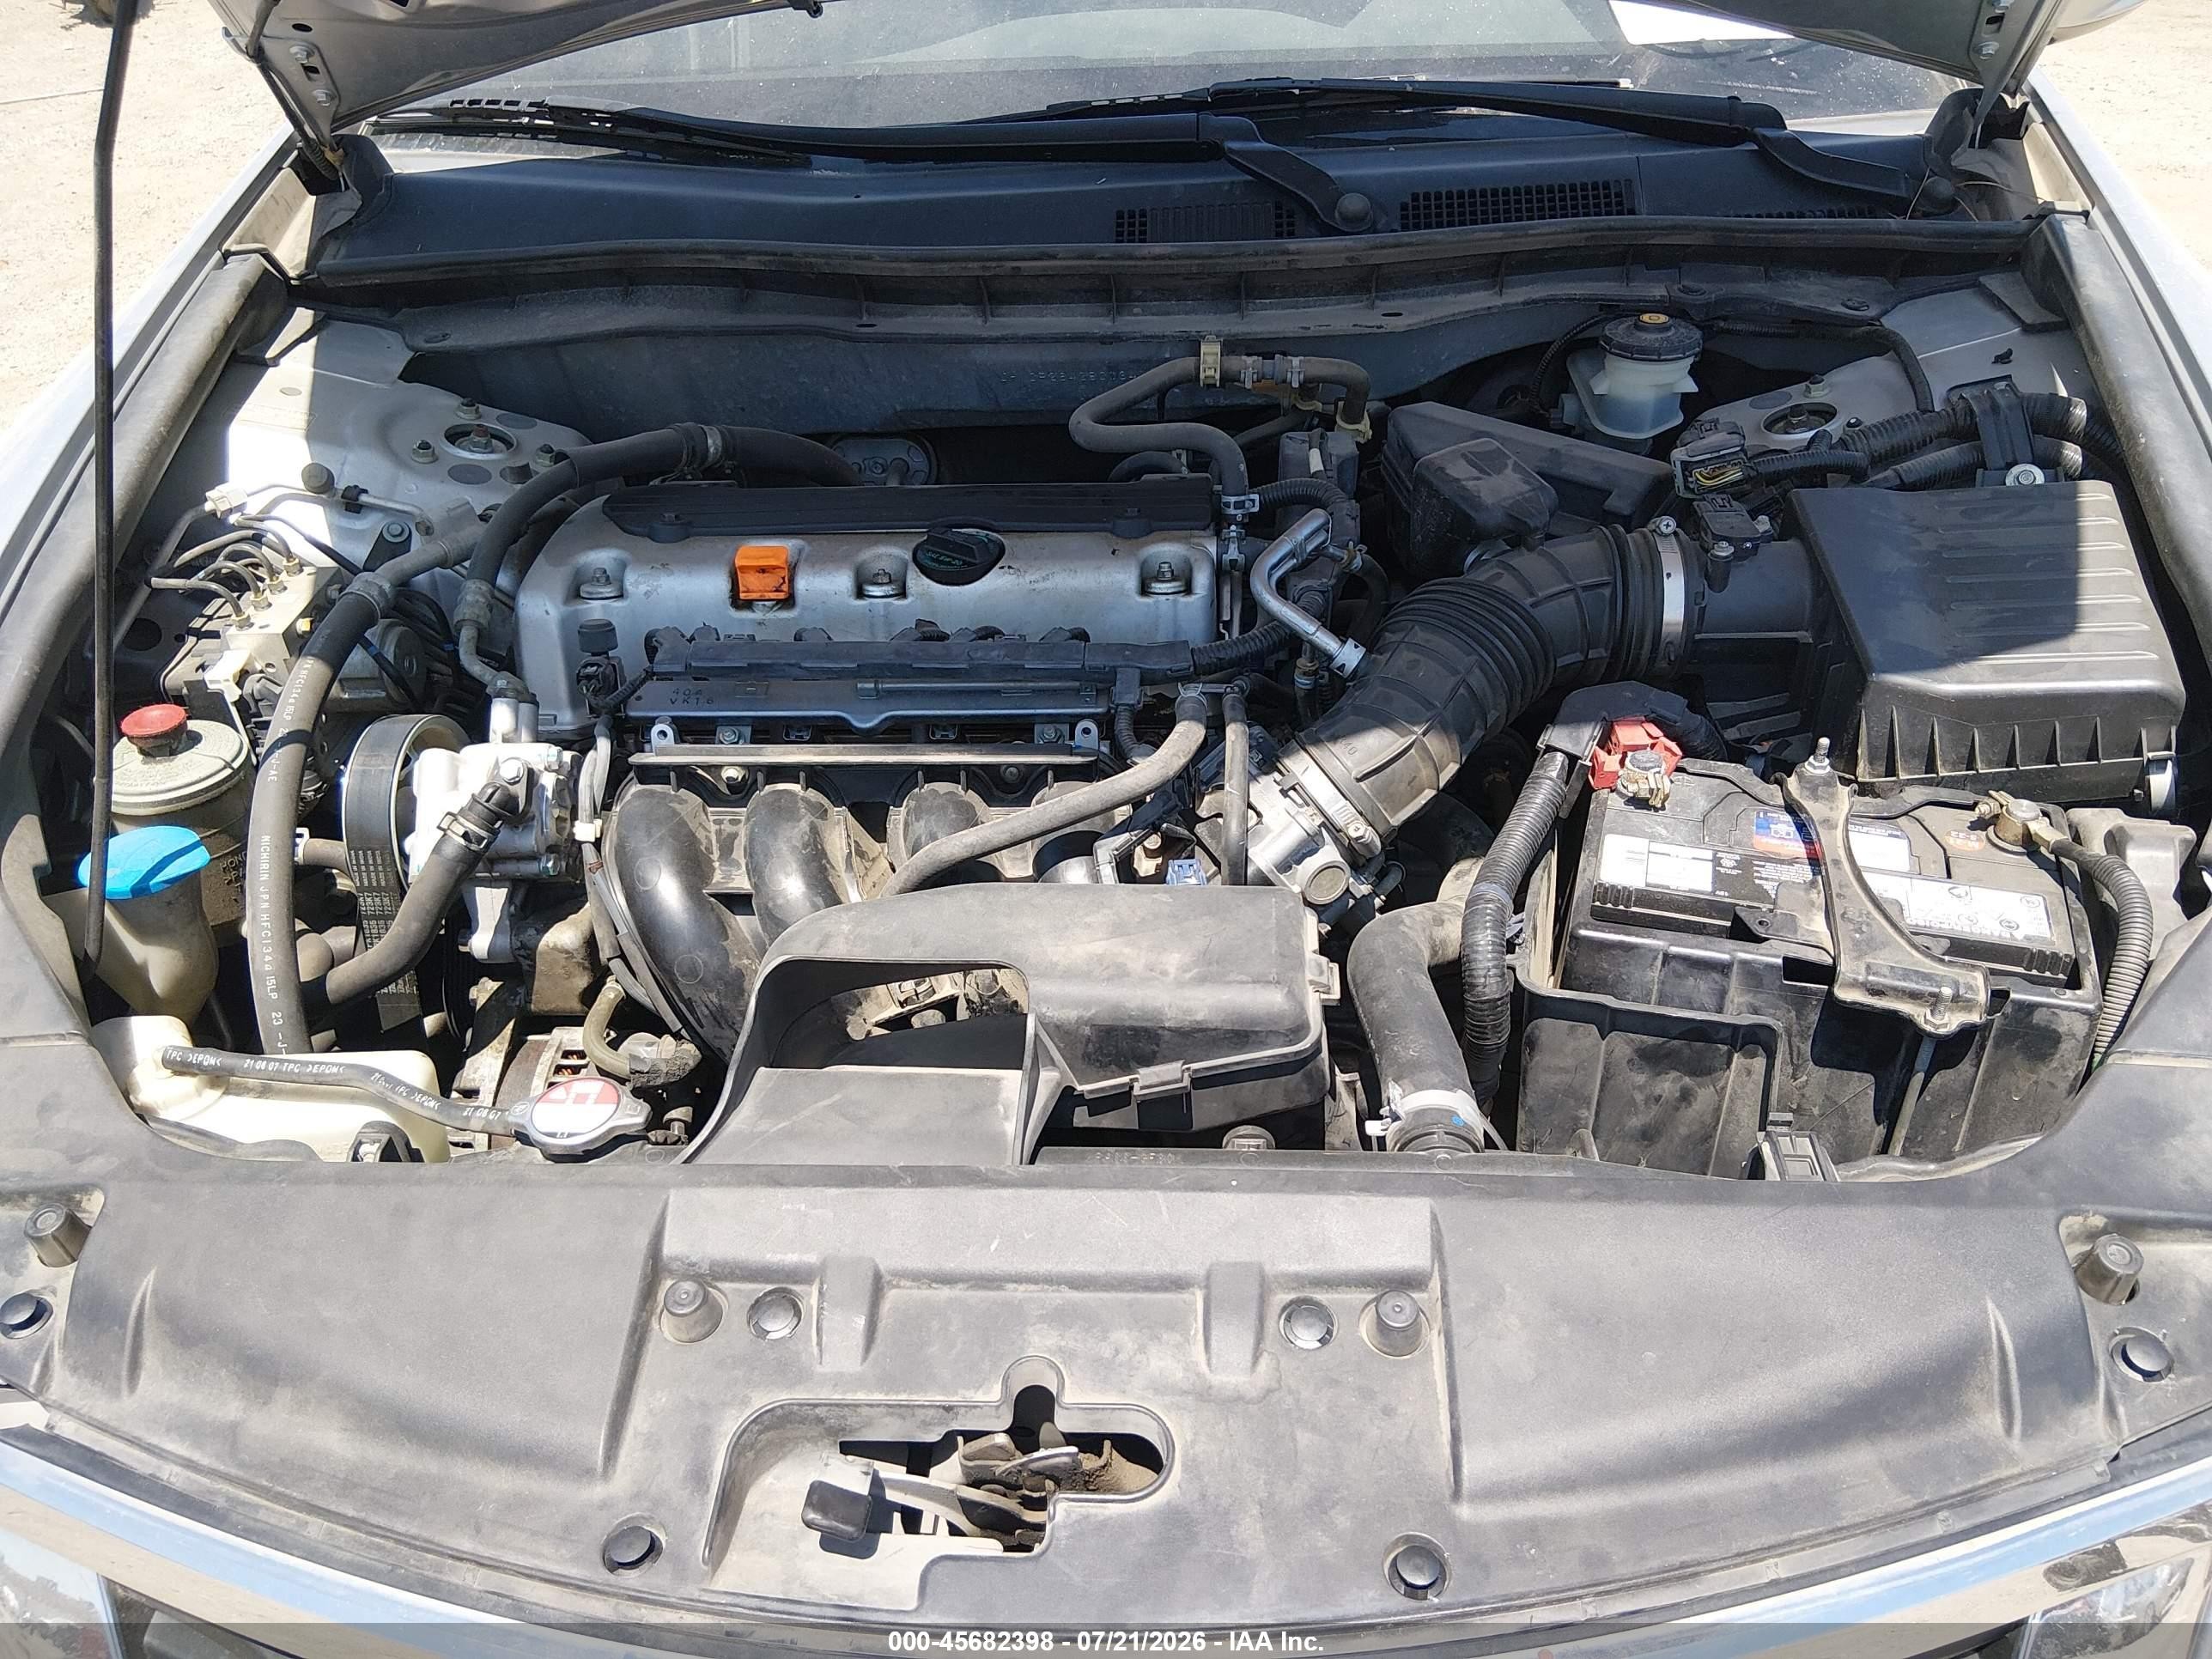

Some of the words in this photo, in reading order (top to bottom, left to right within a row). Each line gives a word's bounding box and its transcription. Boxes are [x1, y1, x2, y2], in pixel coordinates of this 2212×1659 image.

[258, 835, 271, 881] NICHIRIN
[258, 885, 271, 909] JPN
[363, 891, 375, 915] 723K7
[372, 891, 384, 915] 723K7
[260, 913, 273, 971] HFC134a
[271, 1011, 283, 1026] 23
[167, 1047, 182, 1062] TPC
[282, 1060, 301, 1073] TPC
